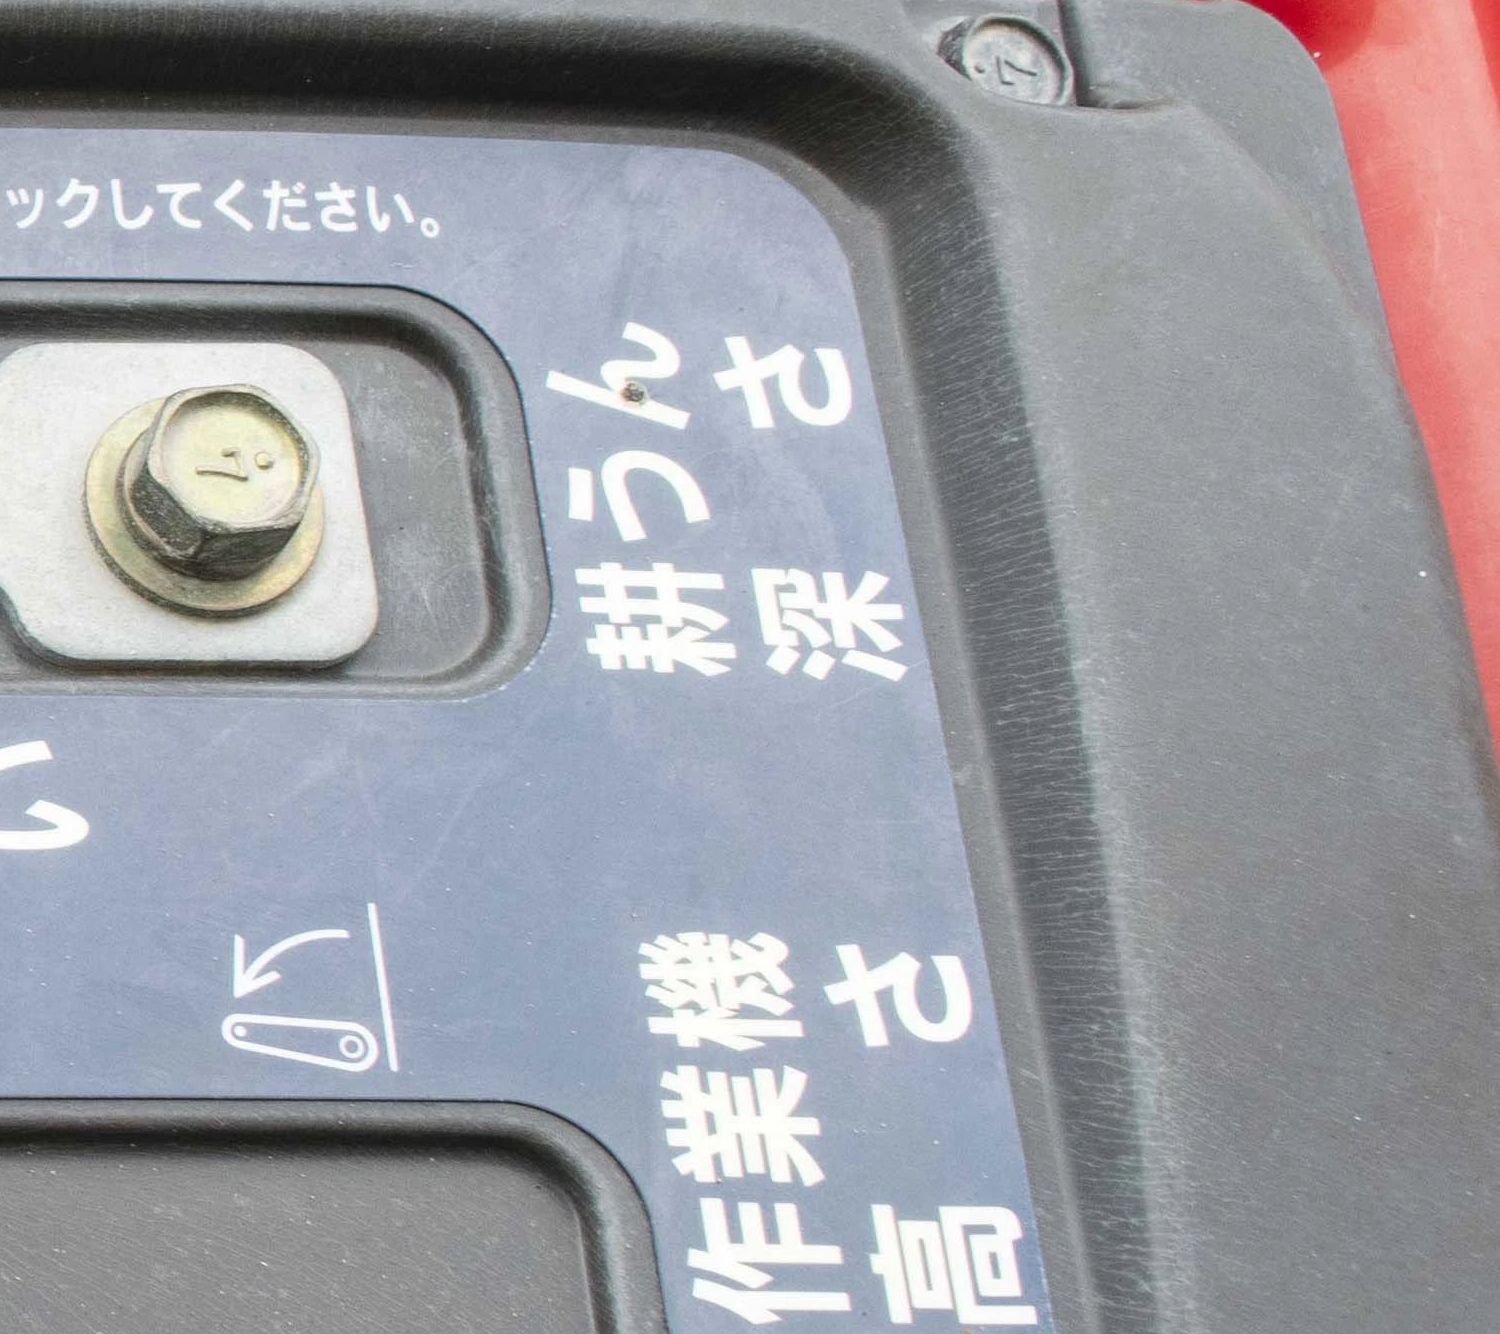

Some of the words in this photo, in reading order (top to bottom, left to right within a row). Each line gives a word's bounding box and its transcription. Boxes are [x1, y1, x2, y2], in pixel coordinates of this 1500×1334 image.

[546, 322, 737, 678] 耕うん
[714, 334, 909, 682] 深さ
[638, 931, 852, 1326] 作業機
[825, 943, 1038, 1326] 高さ
